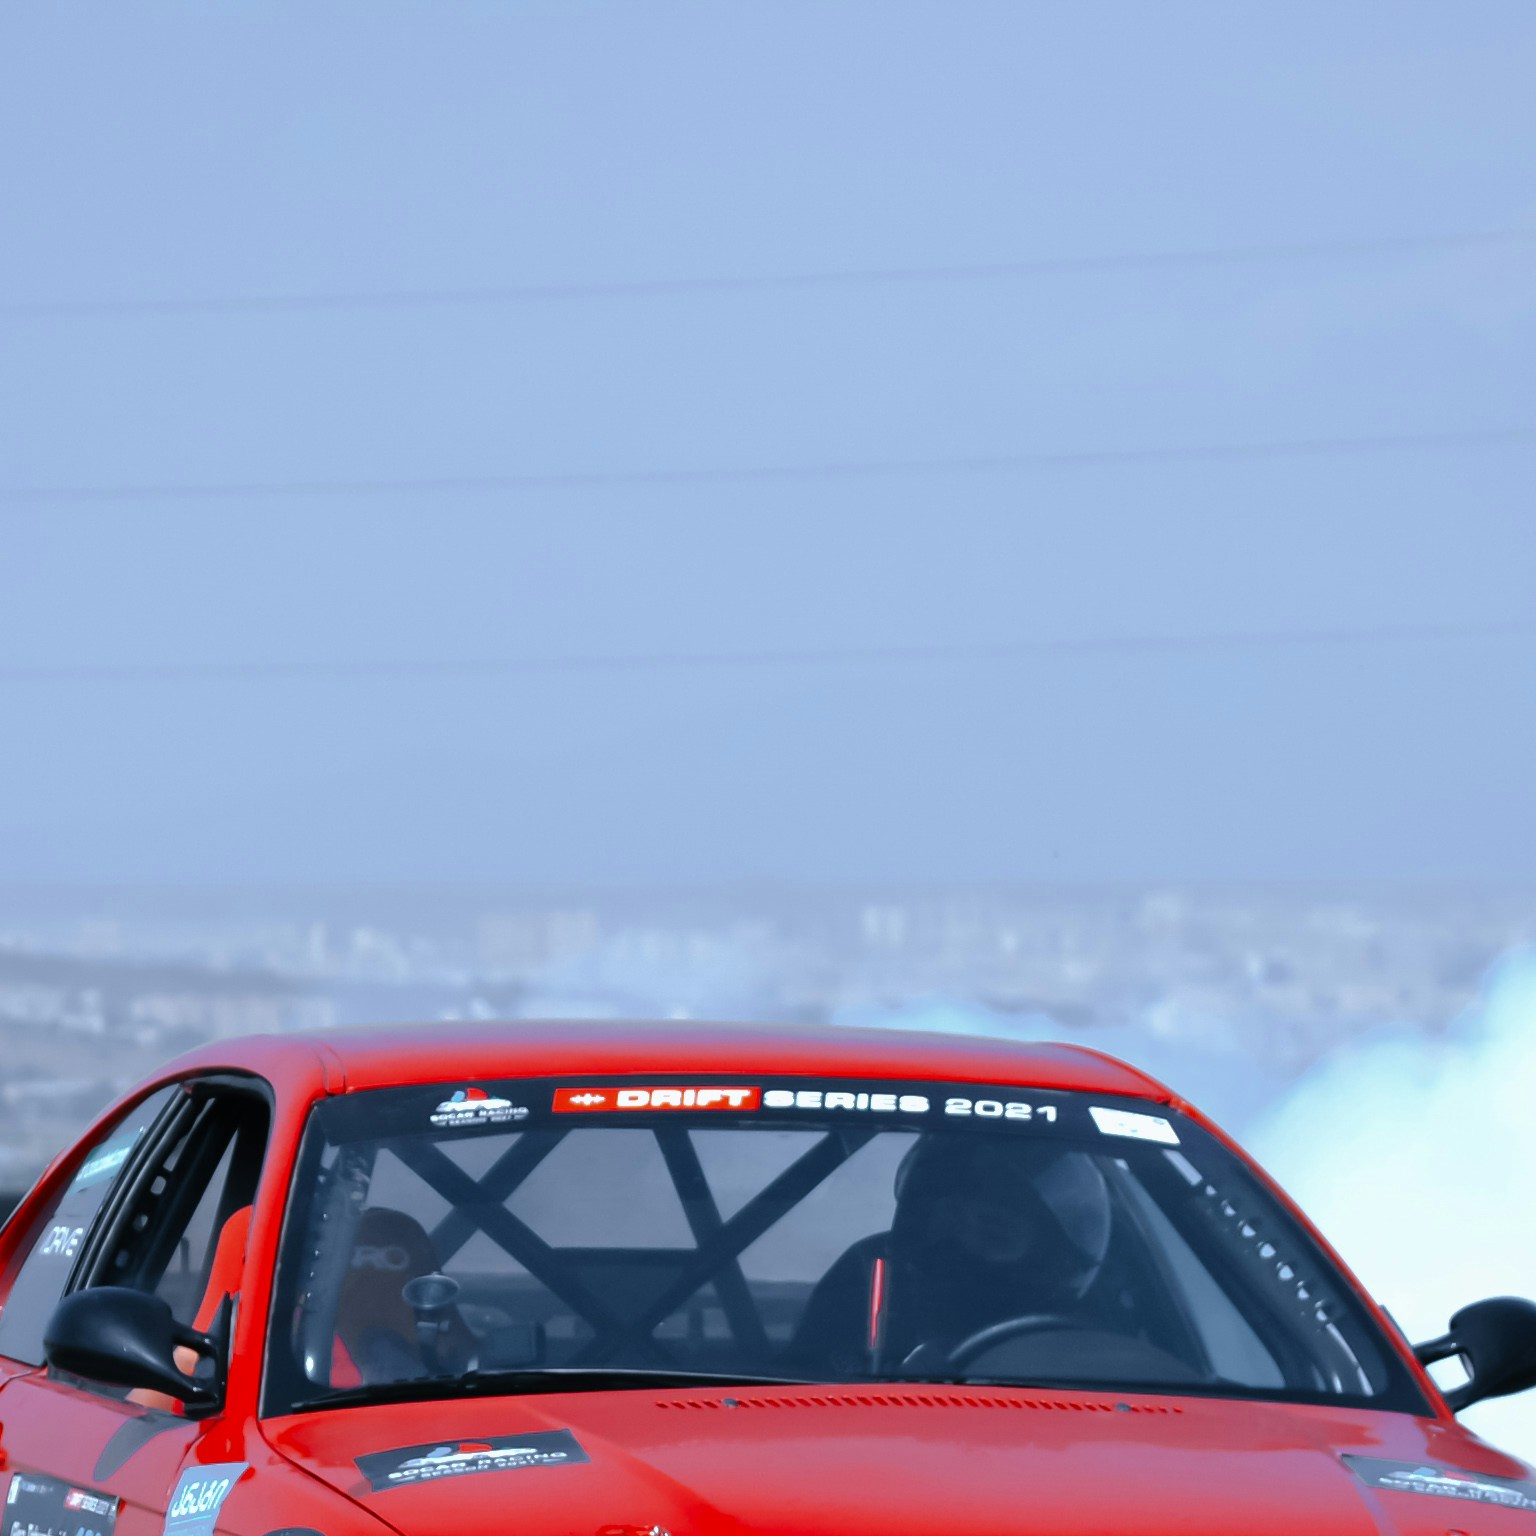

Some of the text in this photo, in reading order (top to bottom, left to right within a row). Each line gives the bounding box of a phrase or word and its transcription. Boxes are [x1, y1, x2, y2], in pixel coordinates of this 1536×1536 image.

[616, 1089, 1058, 1123] DRIFT SERIES 2021
[388, 1461, 467, 1479] SOCAR
